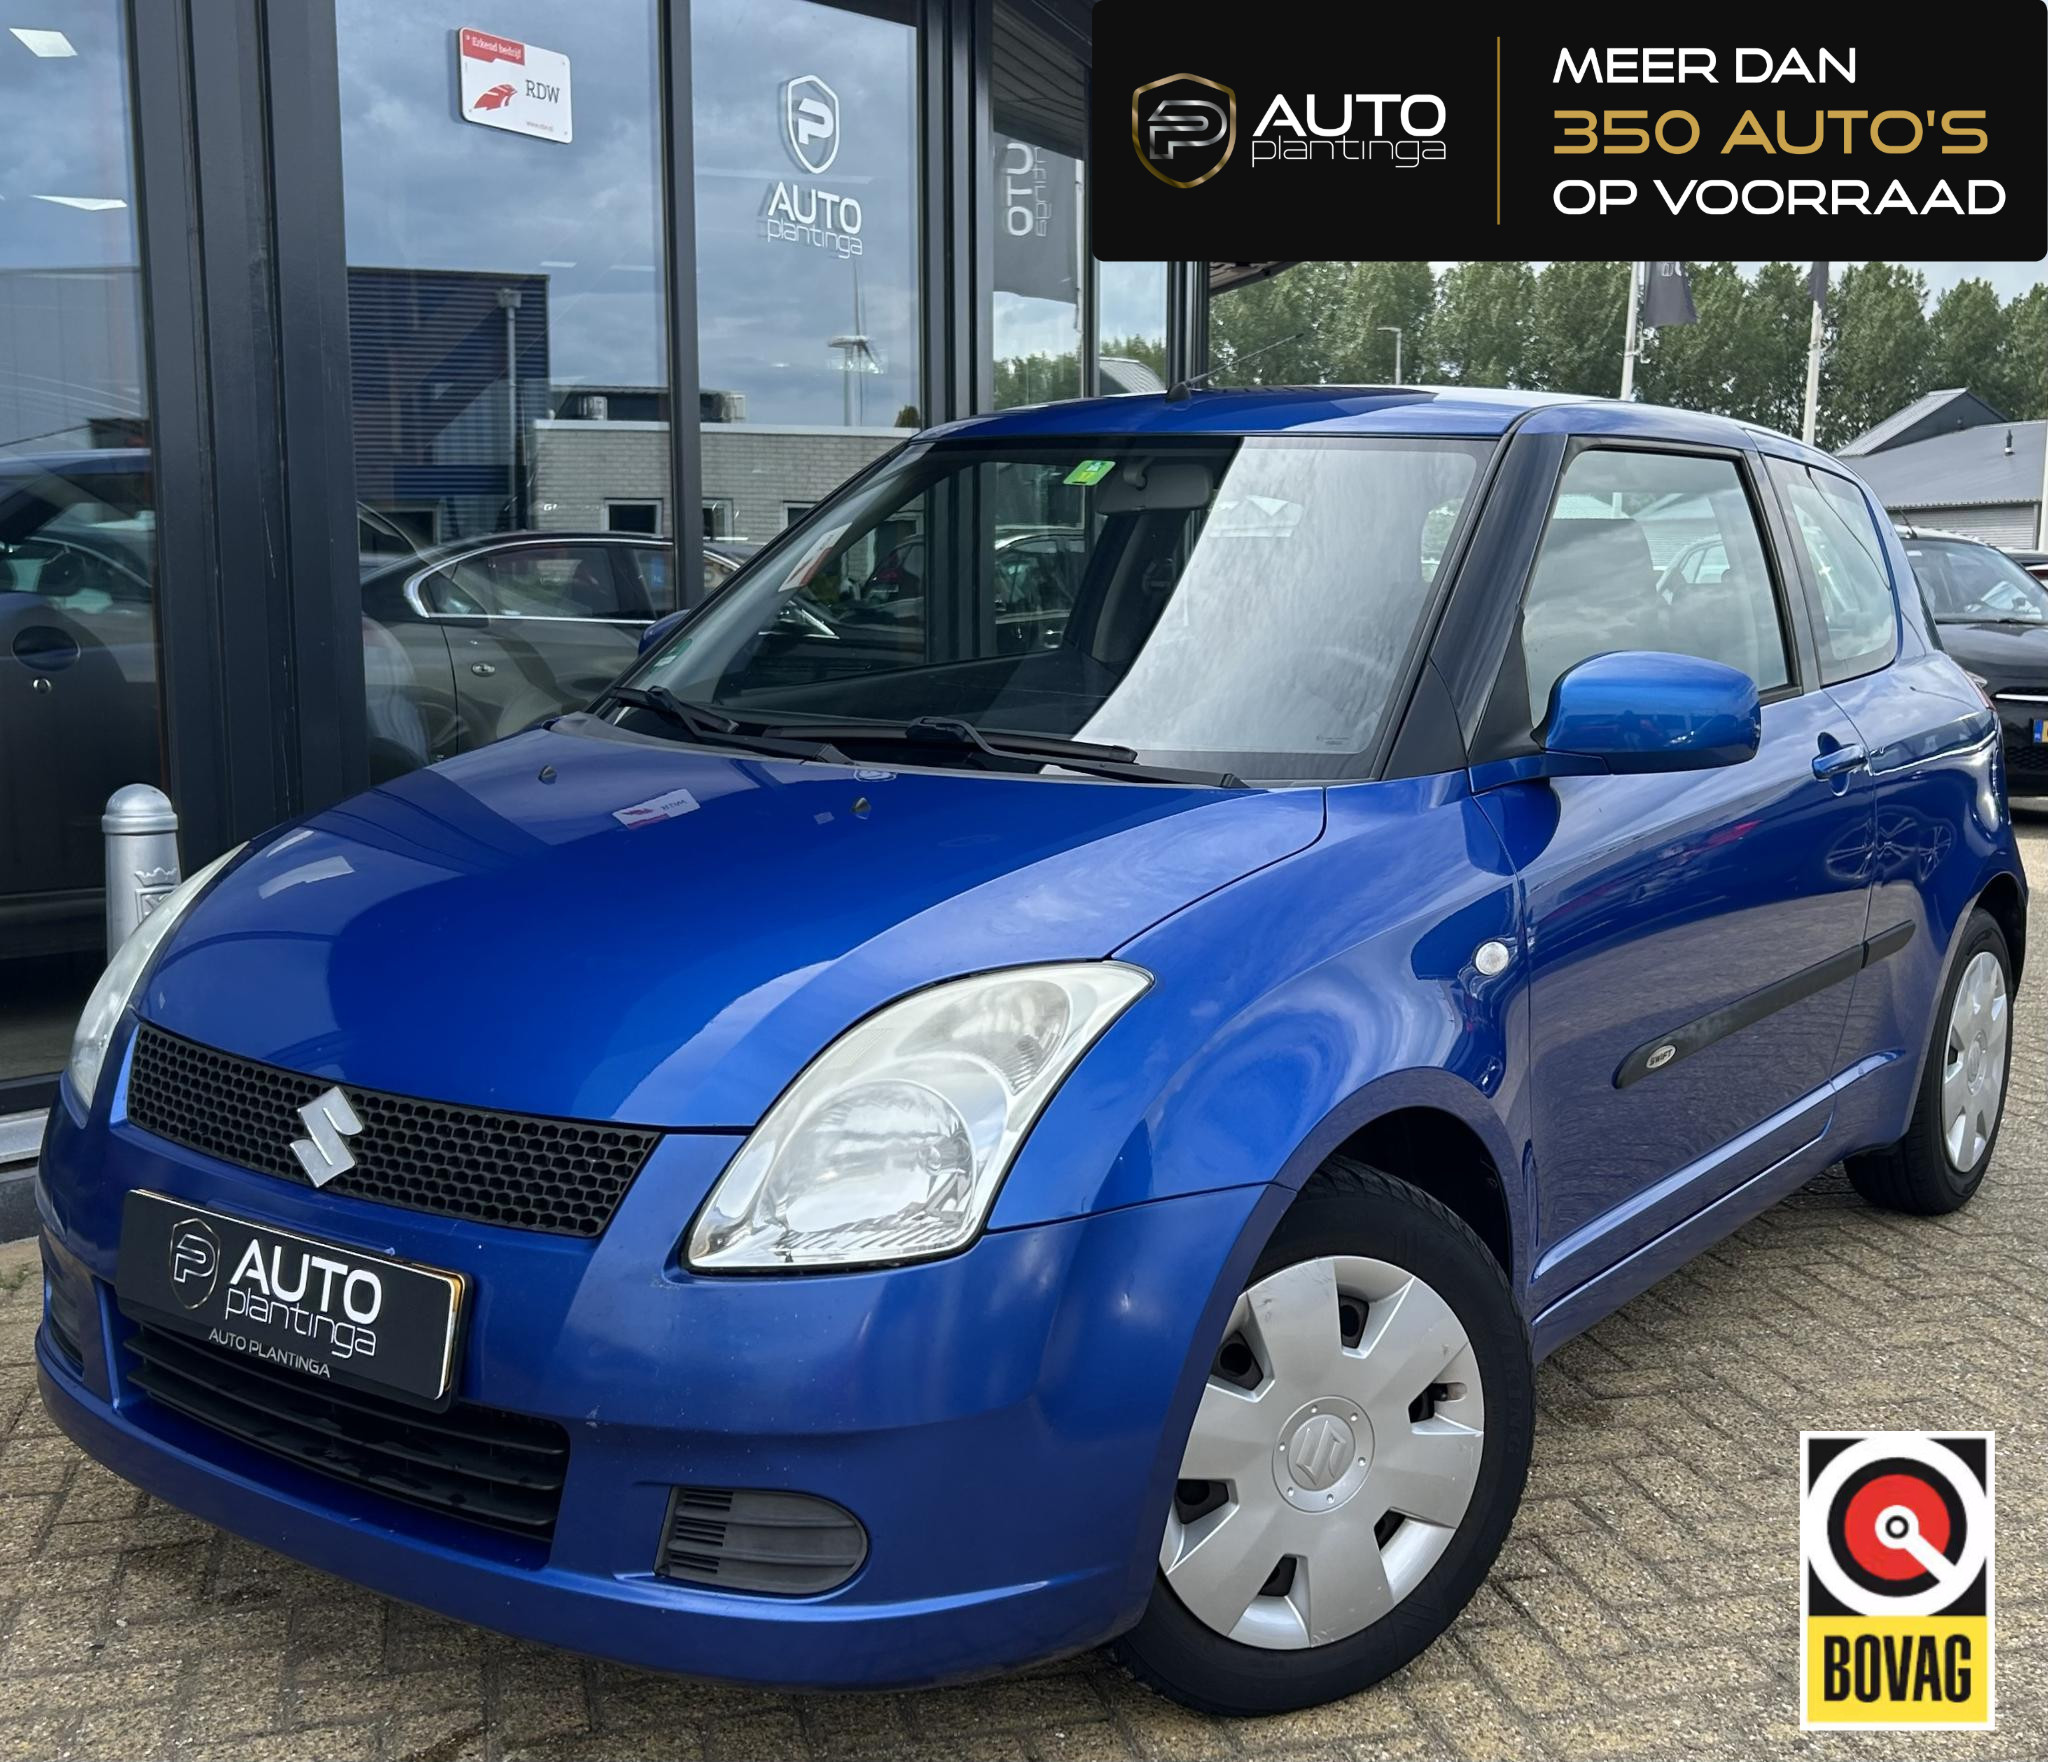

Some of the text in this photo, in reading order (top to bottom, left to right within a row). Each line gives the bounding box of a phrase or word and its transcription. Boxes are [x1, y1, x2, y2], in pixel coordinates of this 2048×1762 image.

[472, 36, 498, 52] Erkend
[525, 79, 560, 104] RDW
[768, 181, 862, 235] AUTO
[768, 218, 863, 259] plantinga
[1648, 1048, 1674, 1066] SWIFT
[230, 1238, 382, 1325] AUTO
[225, 1287, 377, 1358] plantinga
[208, 1327, 331, 1379] AUTO PLANTINGA
